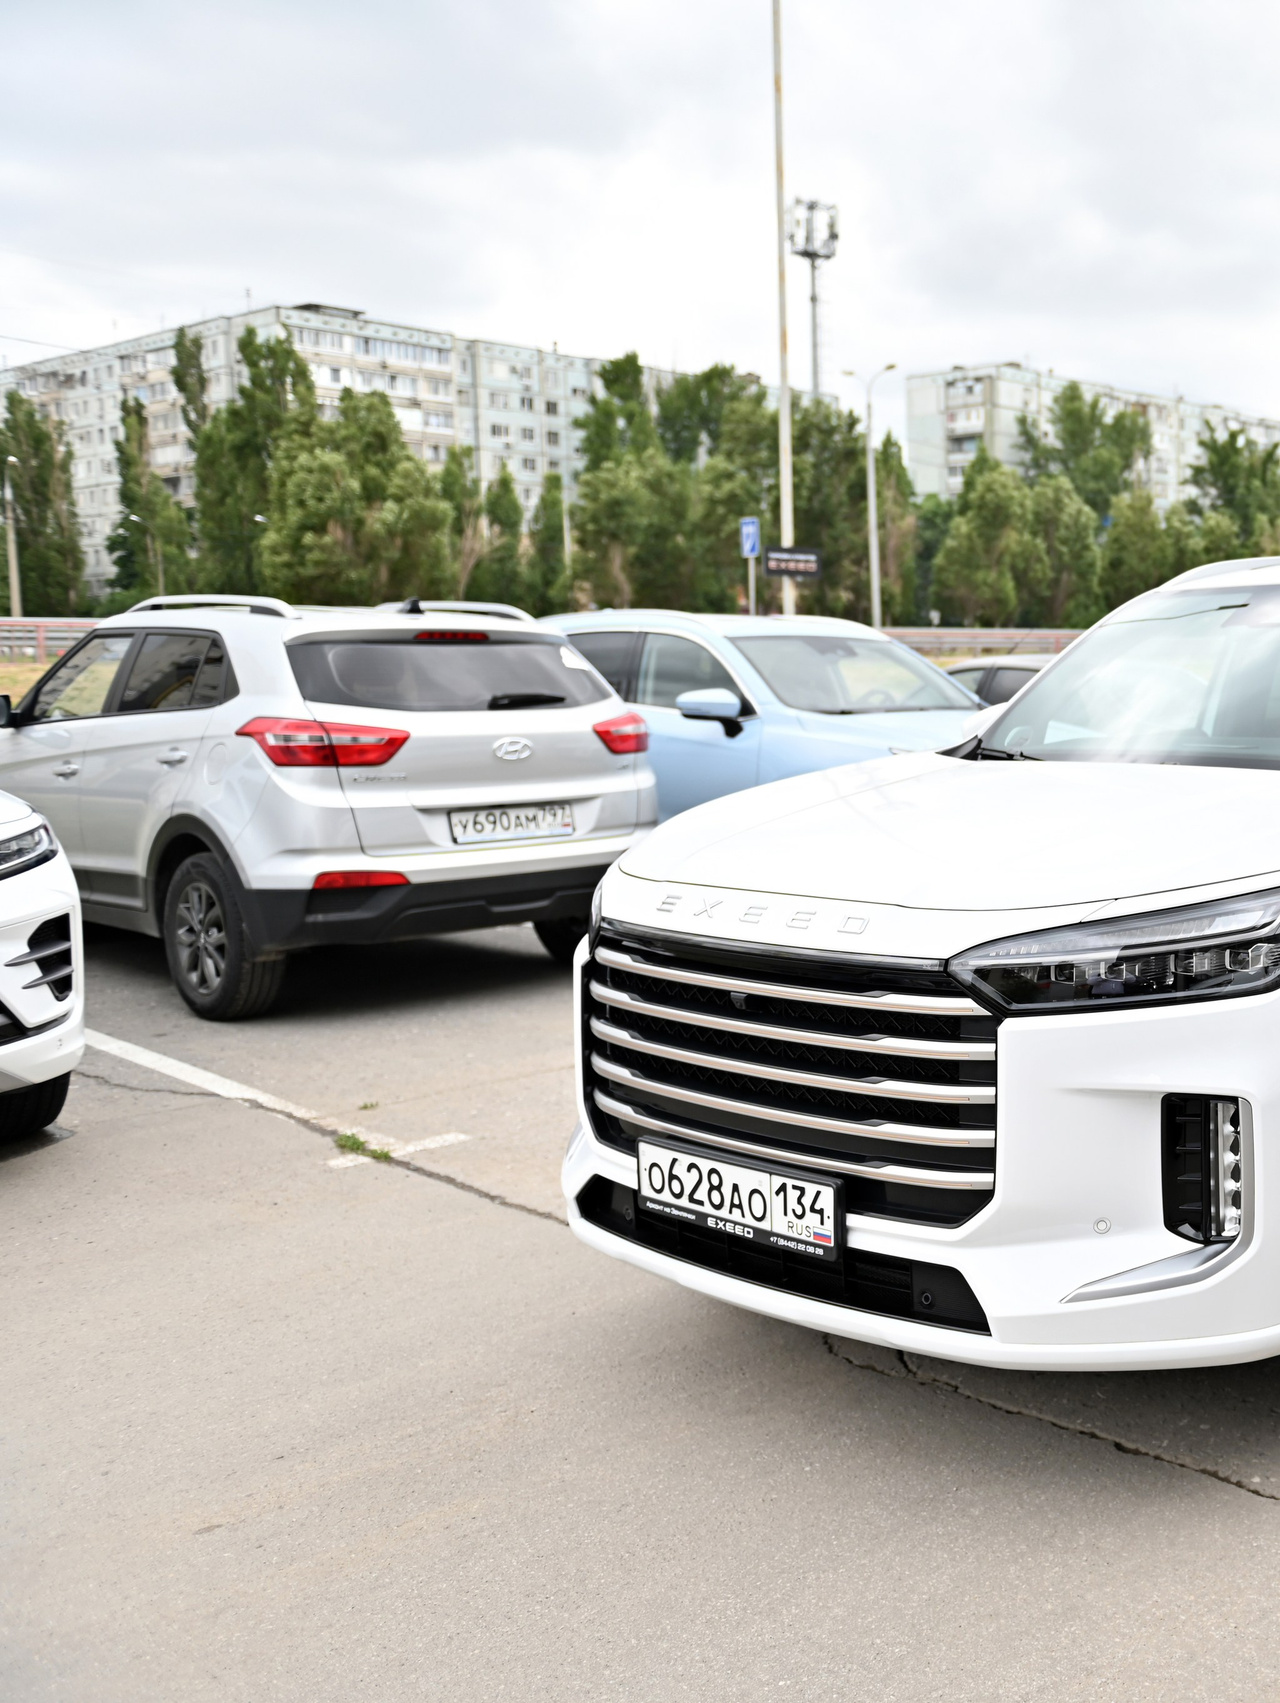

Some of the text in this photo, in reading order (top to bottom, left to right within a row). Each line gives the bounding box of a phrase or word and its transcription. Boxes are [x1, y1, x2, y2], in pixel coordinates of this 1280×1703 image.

[656, 894, 871, 935] EXEED
[774, 1182, 825, 1226] 134
[707, 1217, 754, 1239] EXEED
[787, 1220, 812, 1238] RUS
